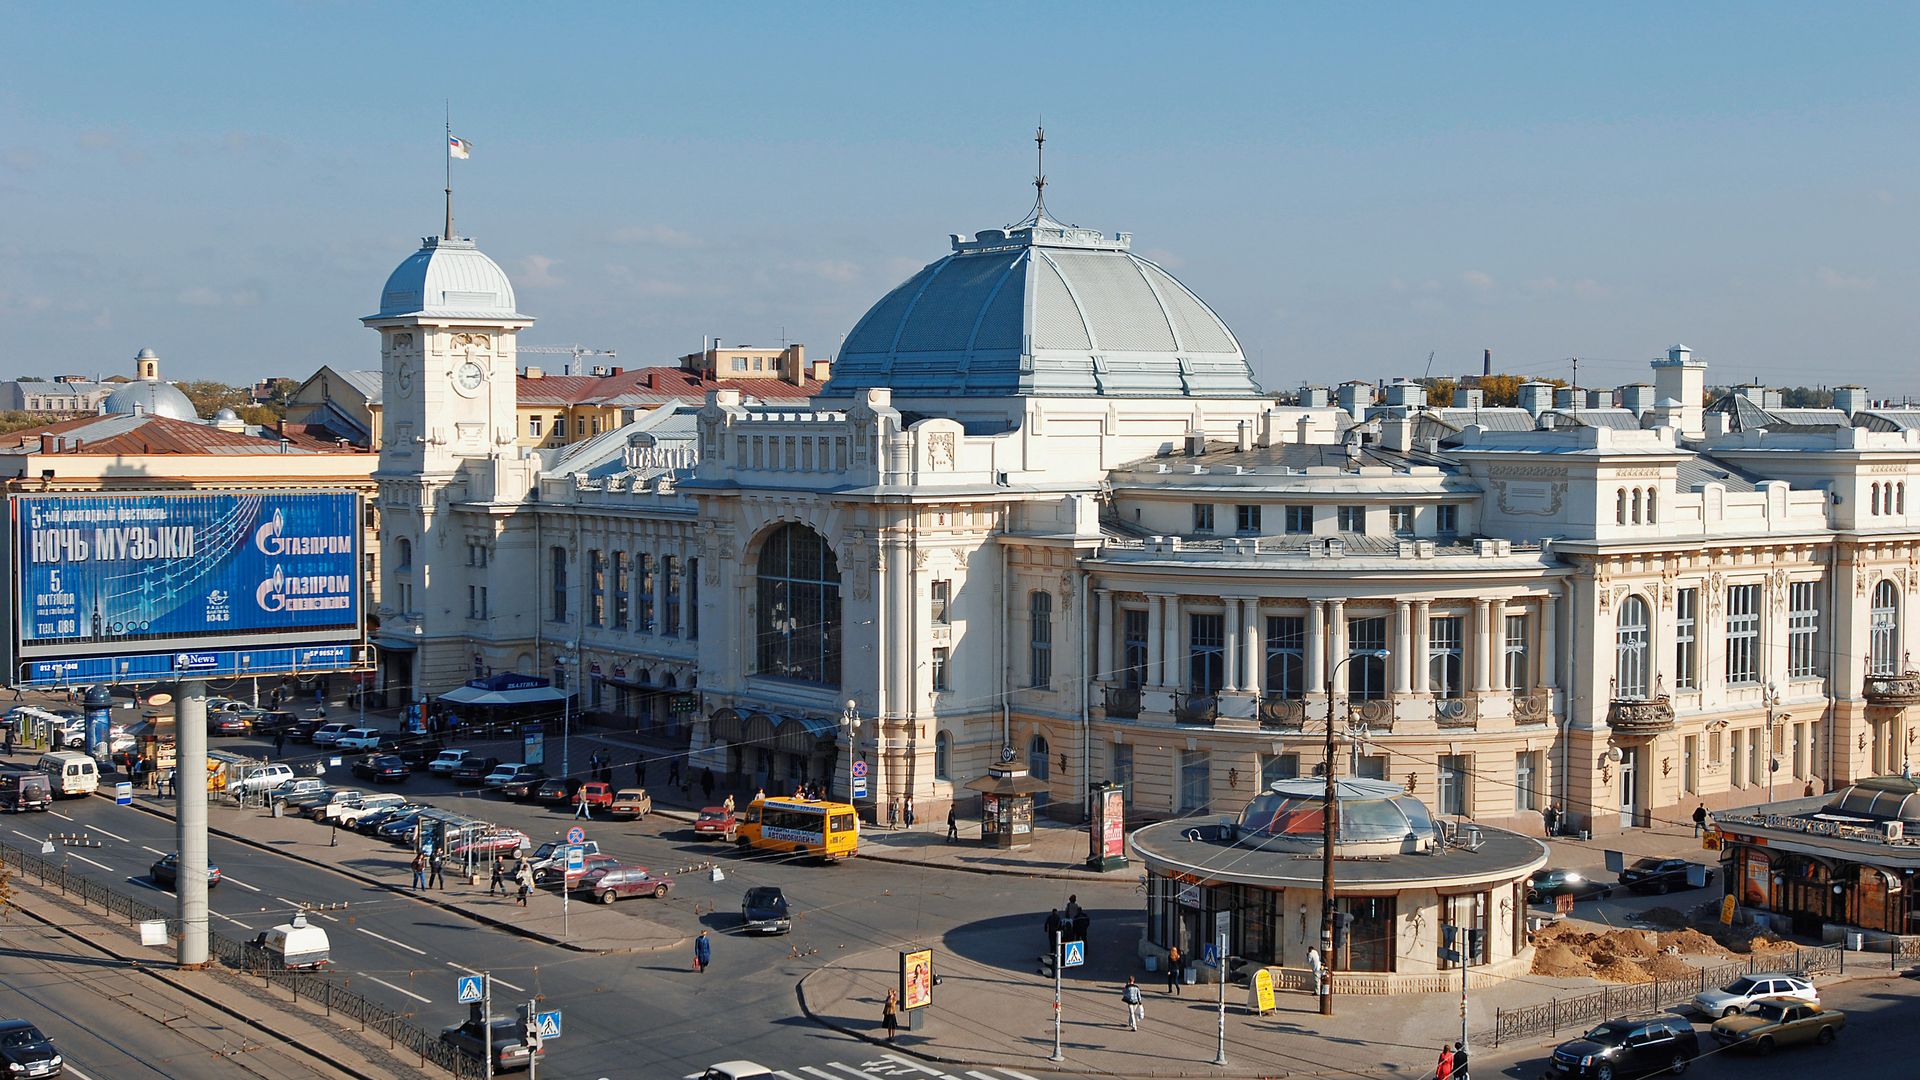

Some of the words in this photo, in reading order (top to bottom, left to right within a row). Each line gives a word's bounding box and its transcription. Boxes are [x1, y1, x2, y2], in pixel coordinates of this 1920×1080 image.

[62, 506, 117, 523] ежегодный
[117, 506, 167, 523] фестиваль
[32, 529, 89, 563] НОЧЬ
[95, 526, 195, 561] МУЗЫКИ
[284, 536, 351, 555] ГАЗПРОМ
[50, 569, 60, 592] 5
[285, 575, 350, 595] ГАЗПРОМ
[288, 600, 346, 609] НЕФТЬ
[37, 623, 56, 634] тел.
[58, 619, 75, 633] 089
[190, 654, 215, 664] News
[1767, 814, 1841, 835] ВИТЕБСКИЙ
[767, 831, 810, 844] АВТОМОБИЛЕЙ
